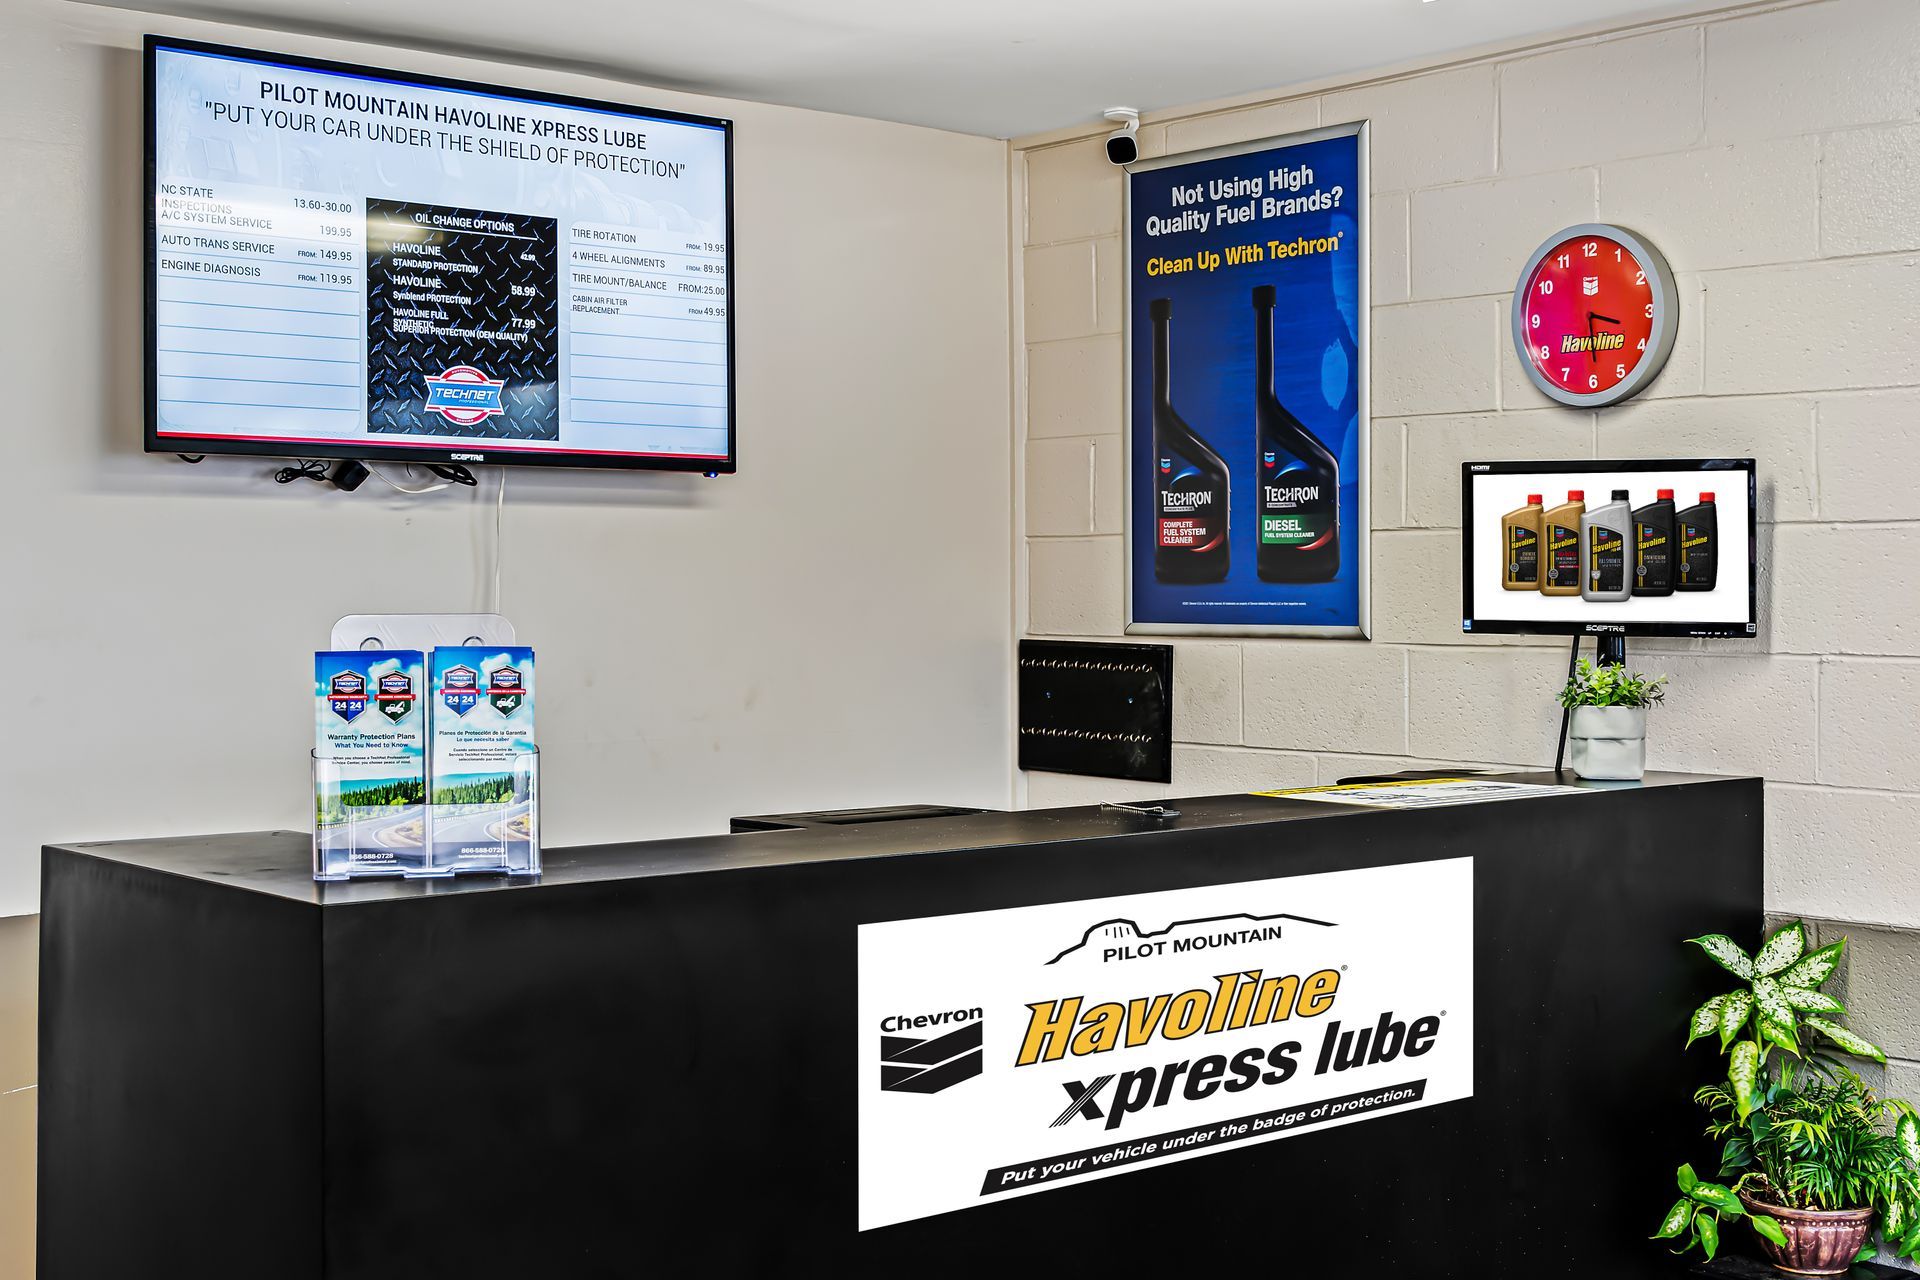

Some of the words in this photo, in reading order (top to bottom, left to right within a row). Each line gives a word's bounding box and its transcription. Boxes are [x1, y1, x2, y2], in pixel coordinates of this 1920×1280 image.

[260, 81, 319, 106] PILOT
[325, 90, 428, 121] MOUNTAIN
[435, 105, 526, 134] HAVOLINE
[531, 119, 599, 143] XPRESS
[604, 129, 646, 150] LUBE
[206, 101, 255, 124] "PUT
[261, 109, 316, 133] YOUR
[322, 117, 361, 138] CAR
[367, 123, 431, 148] UNDER
[436, 131, 473, 153] THE
[479, 138, 541, 160] SHIELD
[547, 147, 568, 165] OF
[574, 150, 685, 179] PROTECTION"
[162, 184, 176, 194] NC
[180, 186, 213, 198] STATE
[1172, 184, 1203, 207] Not
[1210, 177, 1262, 200] Using
[1269, 165, 1313, 191] High
[162, 199, 232, 214] INSPECTIONS
[294, 199, 351, 213] 13.60-30.00
[1146, 211, 1210, 236] Quality
[1216, 201, 1255, 225] Fuel
[1262, 186, 1343, 219] Brands?
[162, 211, 181, 220] A/C
[184, 213, 226, 225] SYSTEM
[230, 217, 272, 229] SERVICE
[416, 213, 431, 223] OIL
[433, 215, 471, 228] CHANGE
[474, 220, 514, 232] OPTIONS
[320, 225, 351, 237] 199.95
[572, 229, 591, 238] TIRE
[593, 231, 636, 243] ROTATION
[162, 235, 191, 246] AUTO
[194, 238, 229, 250] TRANS
[232, 242, 274, 254] SERVICE
[393, 242, 441, 256] HAVOLINE
[704, 243, 724, 252] 19.95
[1582, 242, 1597, 257] 12
[320, 250, 351, 261] 149.95
[572, 251, 577, 259] 4
[580, 252, 608, 263] WHEEL
[611, 256, 665, 268] ALIGNMENTS
[1147, 257, 1193, 276] Clean
[1198, 251, 1220, 272] Up
[1225, 243, 1263, 266] With
[1558, 255, 1570, 268] 11
[1615, 249, 1621, 262] 1
[162, 259, 200, 271] ENGINE
[204, 263, 261, 276] DIAGNOSIS
[393, 258, 432, 269] STANDARD
[434, 262, 478, 273] PROTECTION
[703, 264, 724, 274] 89.95
[320, 274, 352, 284] 119.95
[393, 275, 441, 288] HAVOLINE
[573, 273, 591, 283] TIRE
[594, 276, 666, 290] MOUNT/BALANCE
[1636, 271, 1646, 285] 2
[511, 285, 535, 296] 58.99
[1539, 281, 1553, 294] 10
[427, 294, 471, 305] PROTECTION
[573, 295, 592, 303] CABIN
[606, 298, 627, 306] FILTER
[393, 308, 429, 318] HAVOLINE
[431, 310, 449, 320] FULL
[573, 305, 619, 315] REPLACEMENT
[704, 308, 725, 316] 49.95
[1645, 304, 1654, 318] 3
[511, 318, 536, 329] 77.99
[1532, 315, 1540, 328] 9
[431, 327, 475, 338] PROTECTION
[1637, 338, 1646, 351] 4
[1541, 346, 1550, 359] 8
[1562, 368, 1570, 381] 7
[1616, 364, 1626, 378] 5
[1589, 375, 1598, 388] 6
[1161, 491, 1211, 508] TECHRON
[1264, 486, 1318, 503] TECHRON
[1264, 520, 1301, 531] DIESEL
[1638, 537, 1666, 550] Havoline
[1586, 624, 1625, 632] SCEPTRE
[1103, 941, 1167, 962] PILOT
[1174, 926, 1281, 953] MOUNTAIN
[880, 1006, 983, 1033] Chevron
[1048, 1040, 1302, 1131] xpress
[1000, 1166, 1035, 1185] Put
[1040, 1156, 1086, 1179] your
[1091, 1142, 1157, 1166] vehicle
[1162, 1130, 1216, 1150] under
[1220, 1122, 1248, 1139] the
[1252, 1109, 1306, 1131] badge
[1310, 1104, 1328, 1118] of
[1330, 1088, 1416, 1116] protection.
